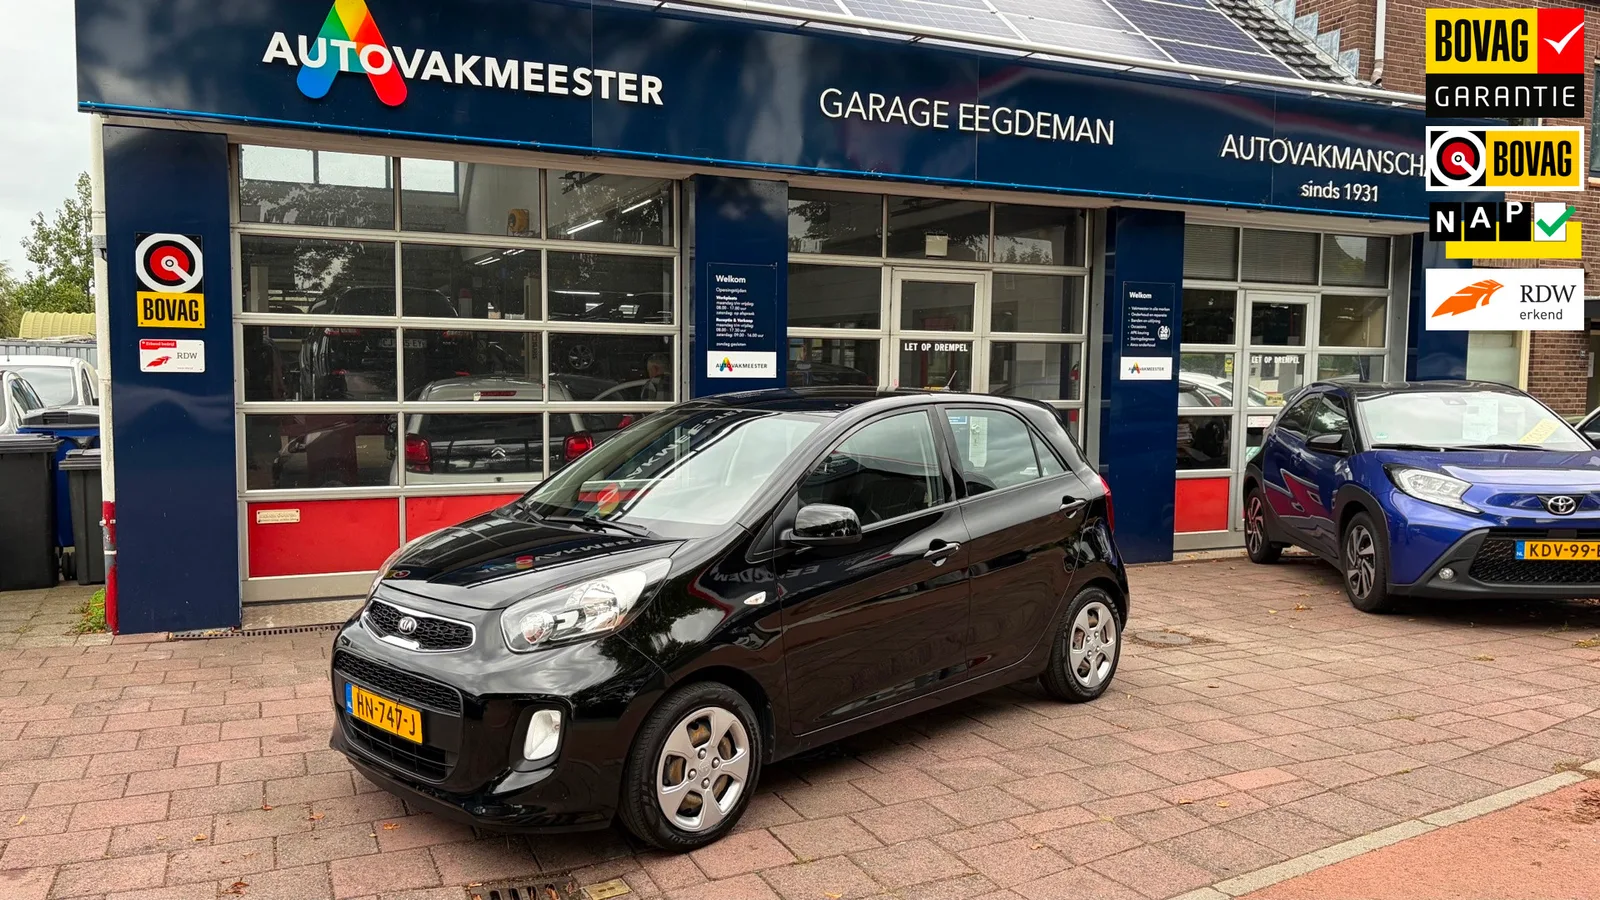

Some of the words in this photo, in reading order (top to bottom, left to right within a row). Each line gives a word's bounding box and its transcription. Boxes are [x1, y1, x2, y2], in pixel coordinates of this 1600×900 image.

[262, 31, 663, 105] AUTOVAKMEESTER
[819, 88, 949, 129] GARAGE
[958, 103, 1114, 145] EEGDEMAN
[1220, 134, 1426, 177] AUTOVAKMANSCH
[1301, 180, 1340, 199] sinds
[1344, 183, 1378, 202] 1931
[716, 275, 746, 283] Welkom
[143, 298, 199, 322] BOVAG
[904, 343, 918, 351] LET
[921, 343, 932, 351] OP
[934, 344, 968, 352] DREMPEL
[1274, 356, 1299, 364] DREMPEL
[1530, 543, 1600, 558] KDV-99-
[400, 618, 413, 632] KIA
[357, 692, 416, 736] HN-747-J
